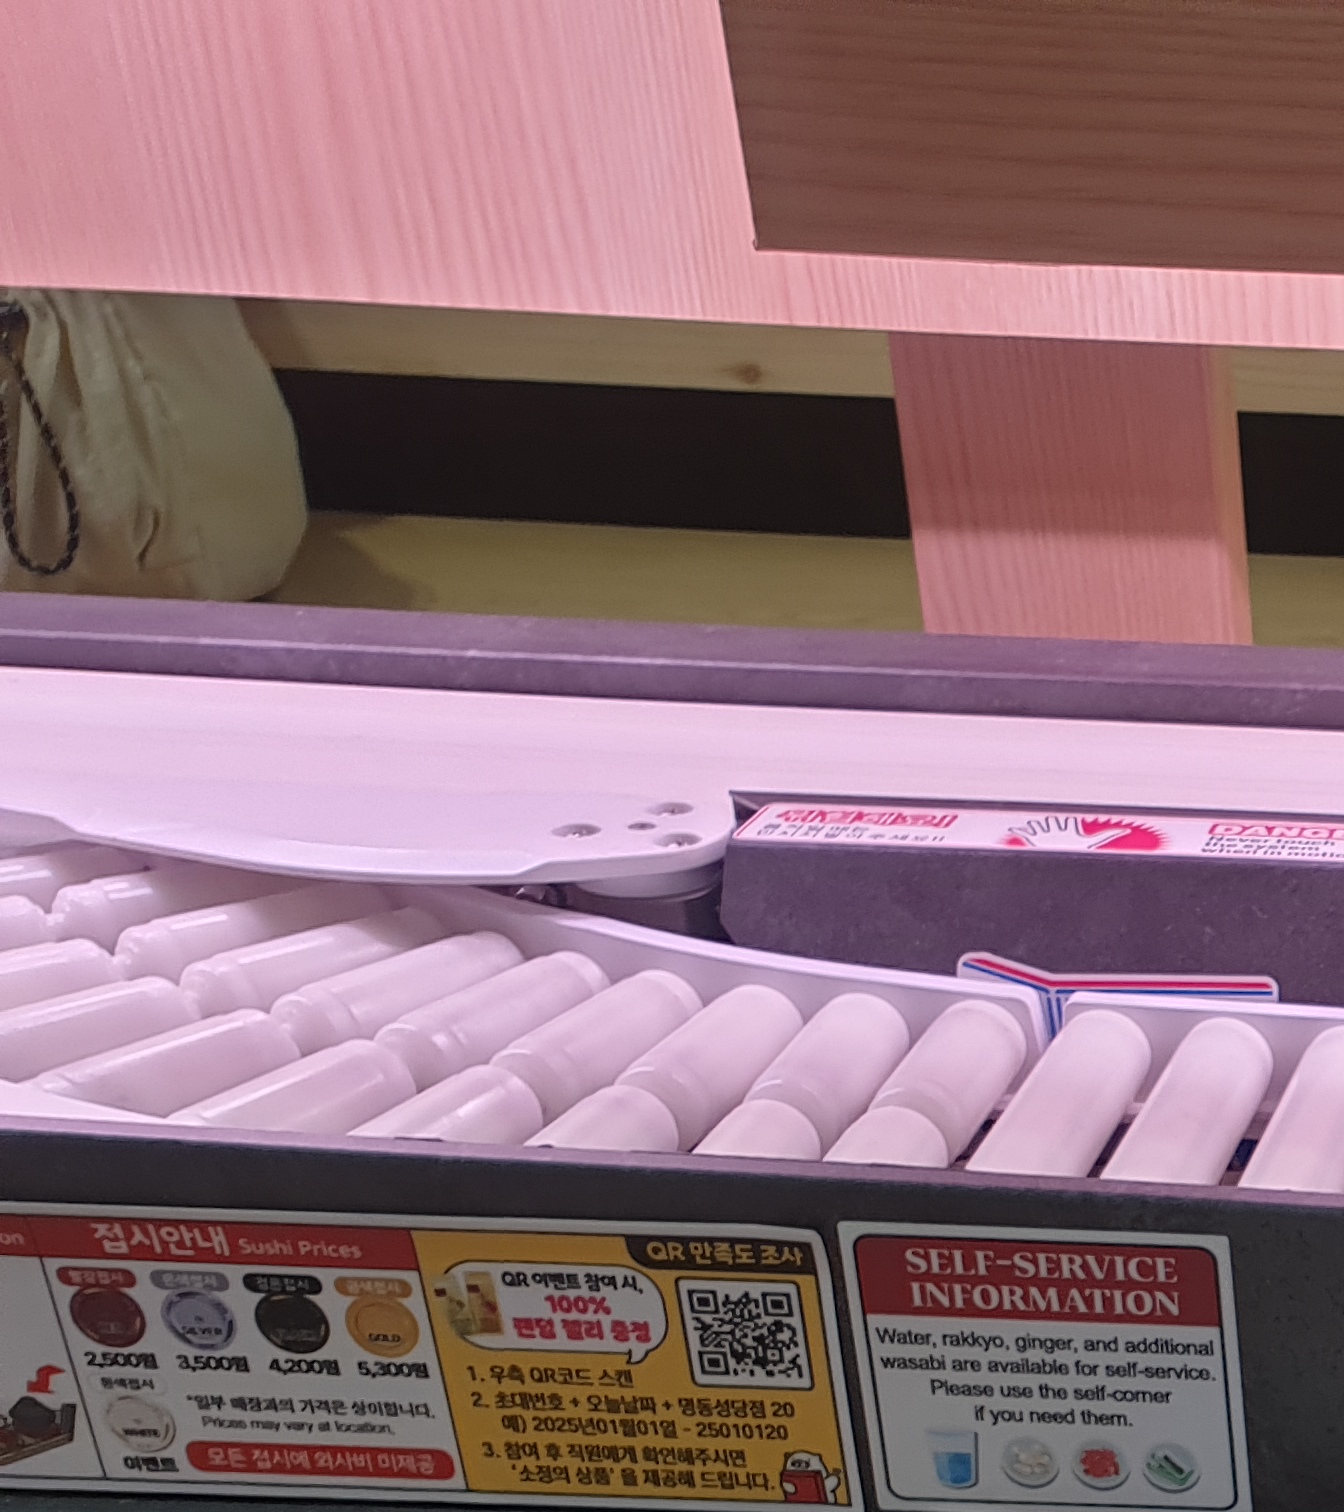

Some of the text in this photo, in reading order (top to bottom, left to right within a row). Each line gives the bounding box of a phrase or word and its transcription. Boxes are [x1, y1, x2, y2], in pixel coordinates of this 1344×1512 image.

[90, 1222, 231, 1257] 접시안내
[238, 1237, 363, 1260] Sushi Prices
[647, 1244, 803, 1267] QR 만족도 조사
[904, 1248, 1178, 1284] SELF-SERVICE
[502, 1271, 529, 1288] QR
[531, 1272, 582, 1291] 이벤트
[622, 1274, 643, 1294] 시,
[544, 1295, 612, 1316] 100%
[910, 1282, 1180, 1317] INFORMATION
[875, 1327, 1214, 1357] Water, rakkyo, ginger, and additional
[466, 1366, 485, 1383] 1.
[530, 1368, 595, 1386] QR코드
[880, 1354, 1217, 1382] wasabi are available for self-service.
[930, 1379, 1173, 1405] Please use the self-corner
[471, 1392, 490, 1408] 2.
[771, 1402, 795, 1418] 20
[973, 1404, 1134, 1428] if you need them.
[697, 1422, 789, 1440] 25010120
[207, 1448, 251, 1467] 모든
[482, 1442, 502, 1459] 3.
